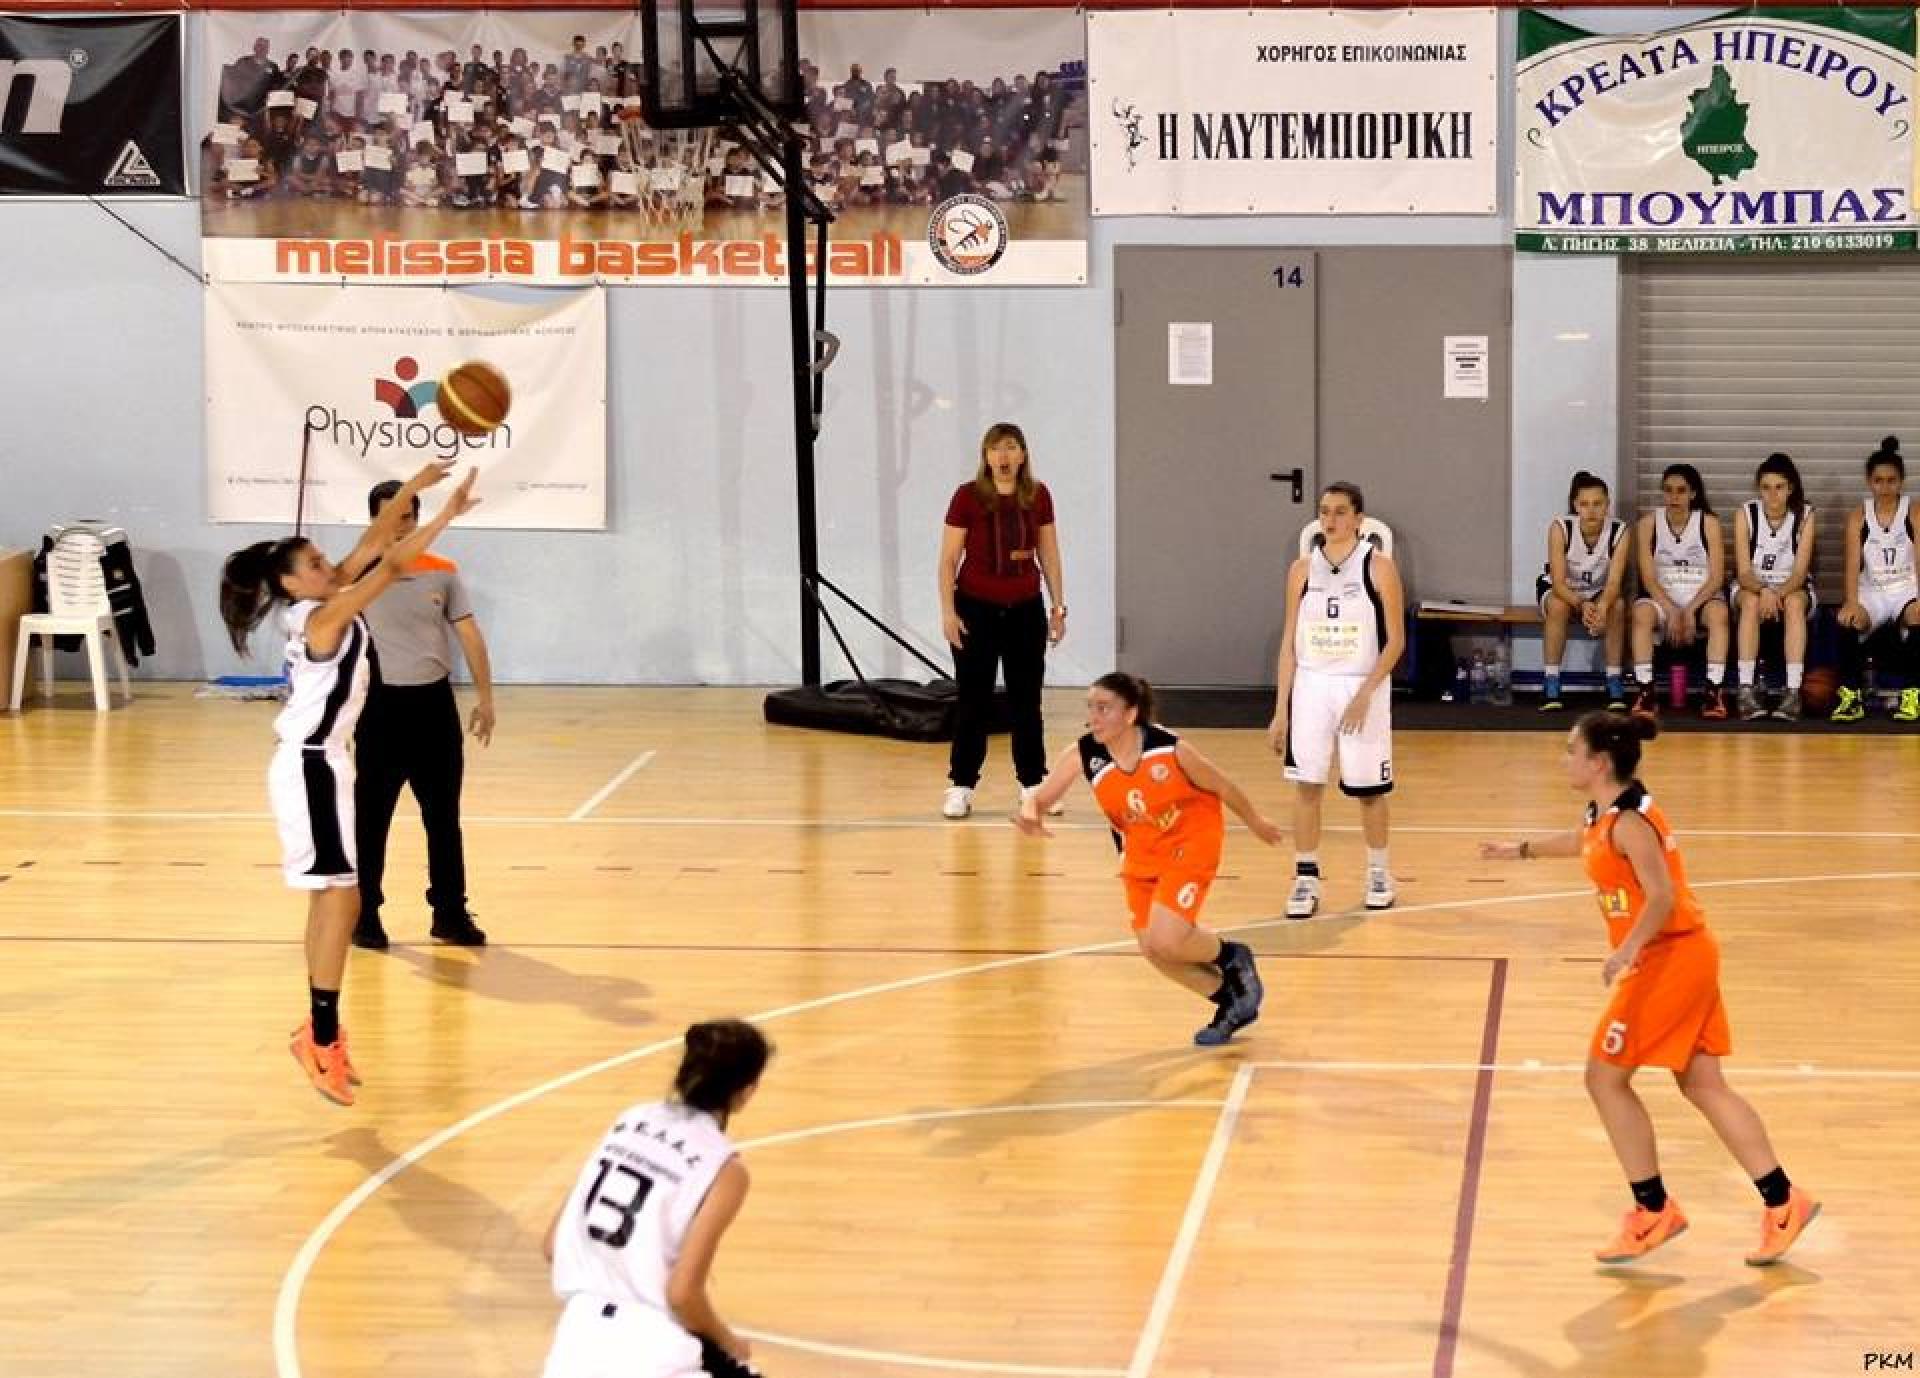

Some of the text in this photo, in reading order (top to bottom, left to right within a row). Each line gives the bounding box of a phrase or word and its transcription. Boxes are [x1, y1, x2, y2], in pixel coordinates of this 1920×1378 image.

[1257, 44, 1467, 62] ΧΟΡΗΓΟΣ ΕΠΙΚΟΙΝΩΝΙΑΣ
[1535, 30, 1908, 126] ΚΡΕΑΤΑ ΗΠΕΙΡΟΥ
[1158, 112, 1472, 160] Η ΝΑΥΤΕΜΠΟΡΙΚΗ
[1537, 189, 1906, 225] ΜΠΟΥΜΠΑΣ
[275, 230, 535, 275] melissia
[1627, 238, 1649, 251] 38
[1657, 237, 1734, 251] ΜΕΛΙΣΣΙΑ
[1791, 235, 1821, 249] 210
[1825, 234, 1894, 249] 6133019
[1273, 266, 1304, 288] 14
[1327, 597, 1340, 619] 6
[1379, 762, 1390, 781] 6
[1127, 789, 1146, 813] 6
[1176, 882, 1198, 908] 6
[1602, 1021, 1626, 1054] 5
[584, 1159, 655, 1248] 13
